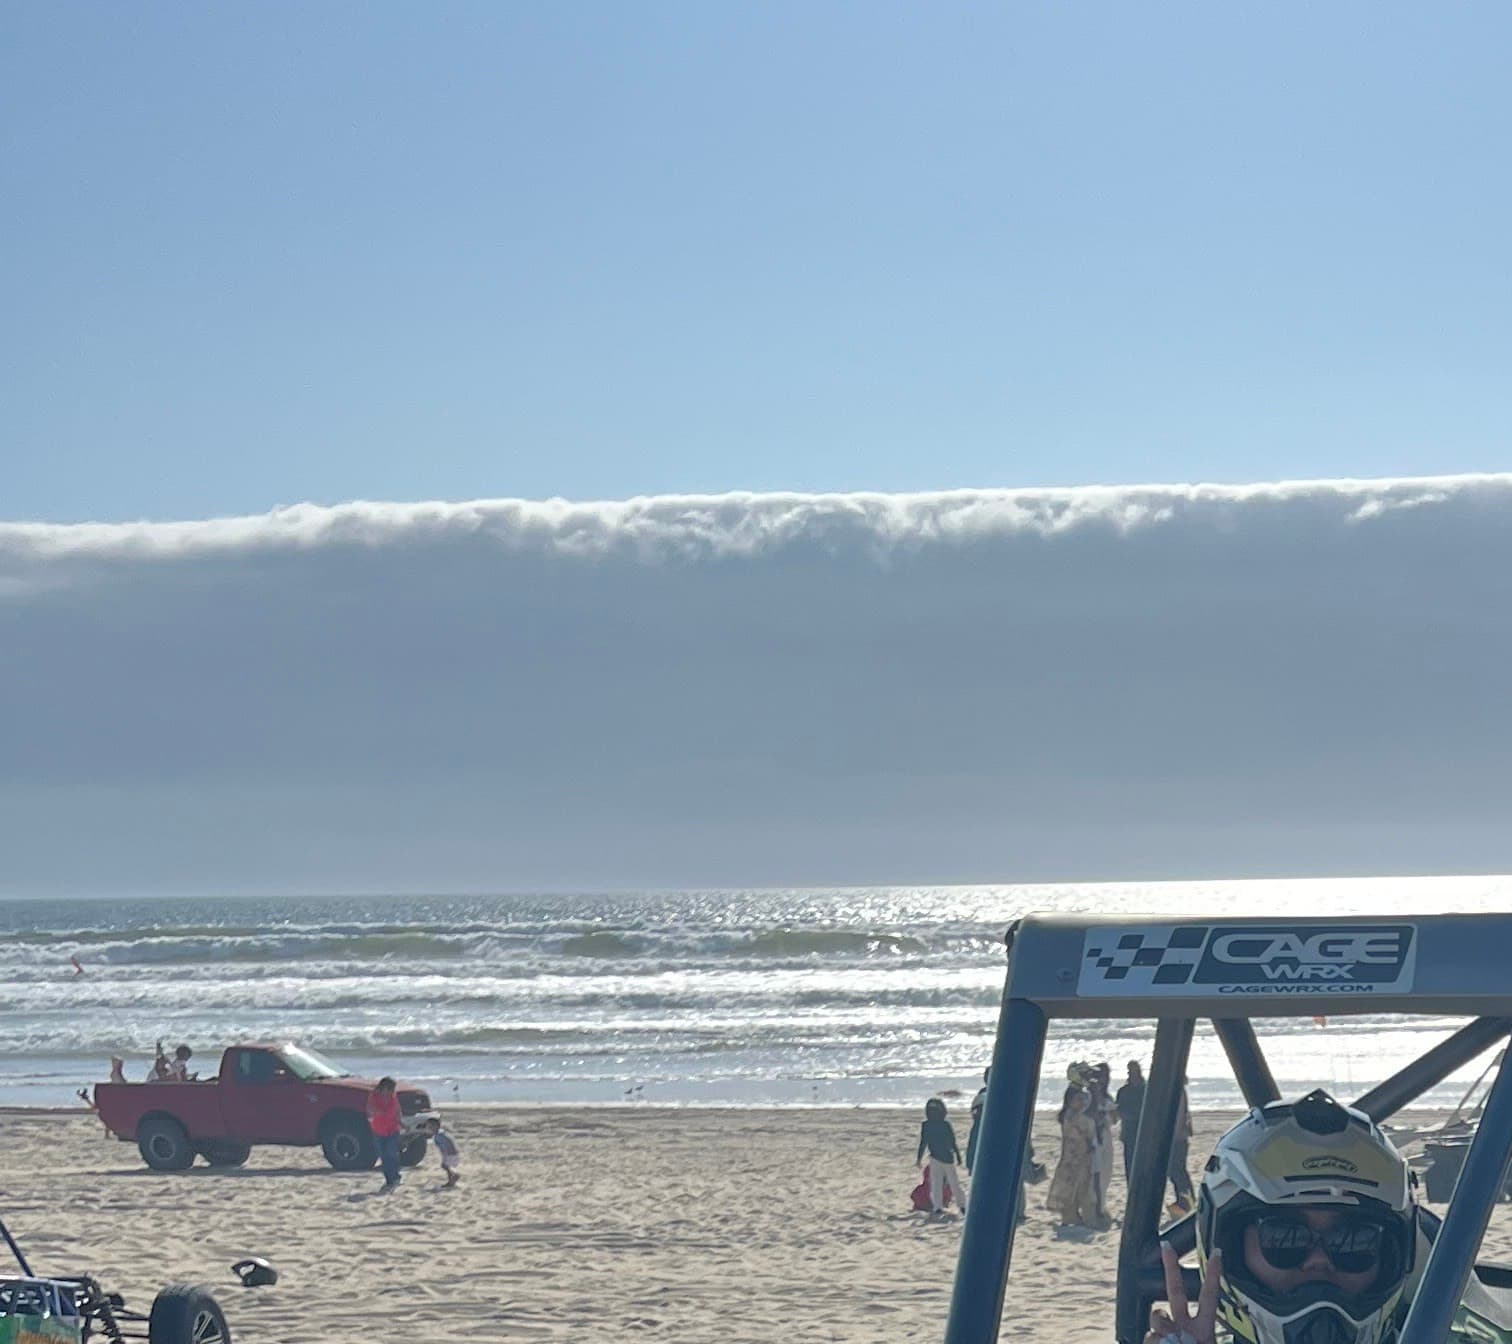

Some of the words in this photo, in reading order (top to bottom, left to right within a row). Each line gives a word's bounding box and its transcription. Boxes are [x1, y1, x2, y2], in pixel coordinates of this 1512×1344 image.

[1211, 932, 1400, 964] CAGE
[1263, 964, 1355, 980] WRX
[1218, 984, 1374, 994] CAGEWRX.COM
